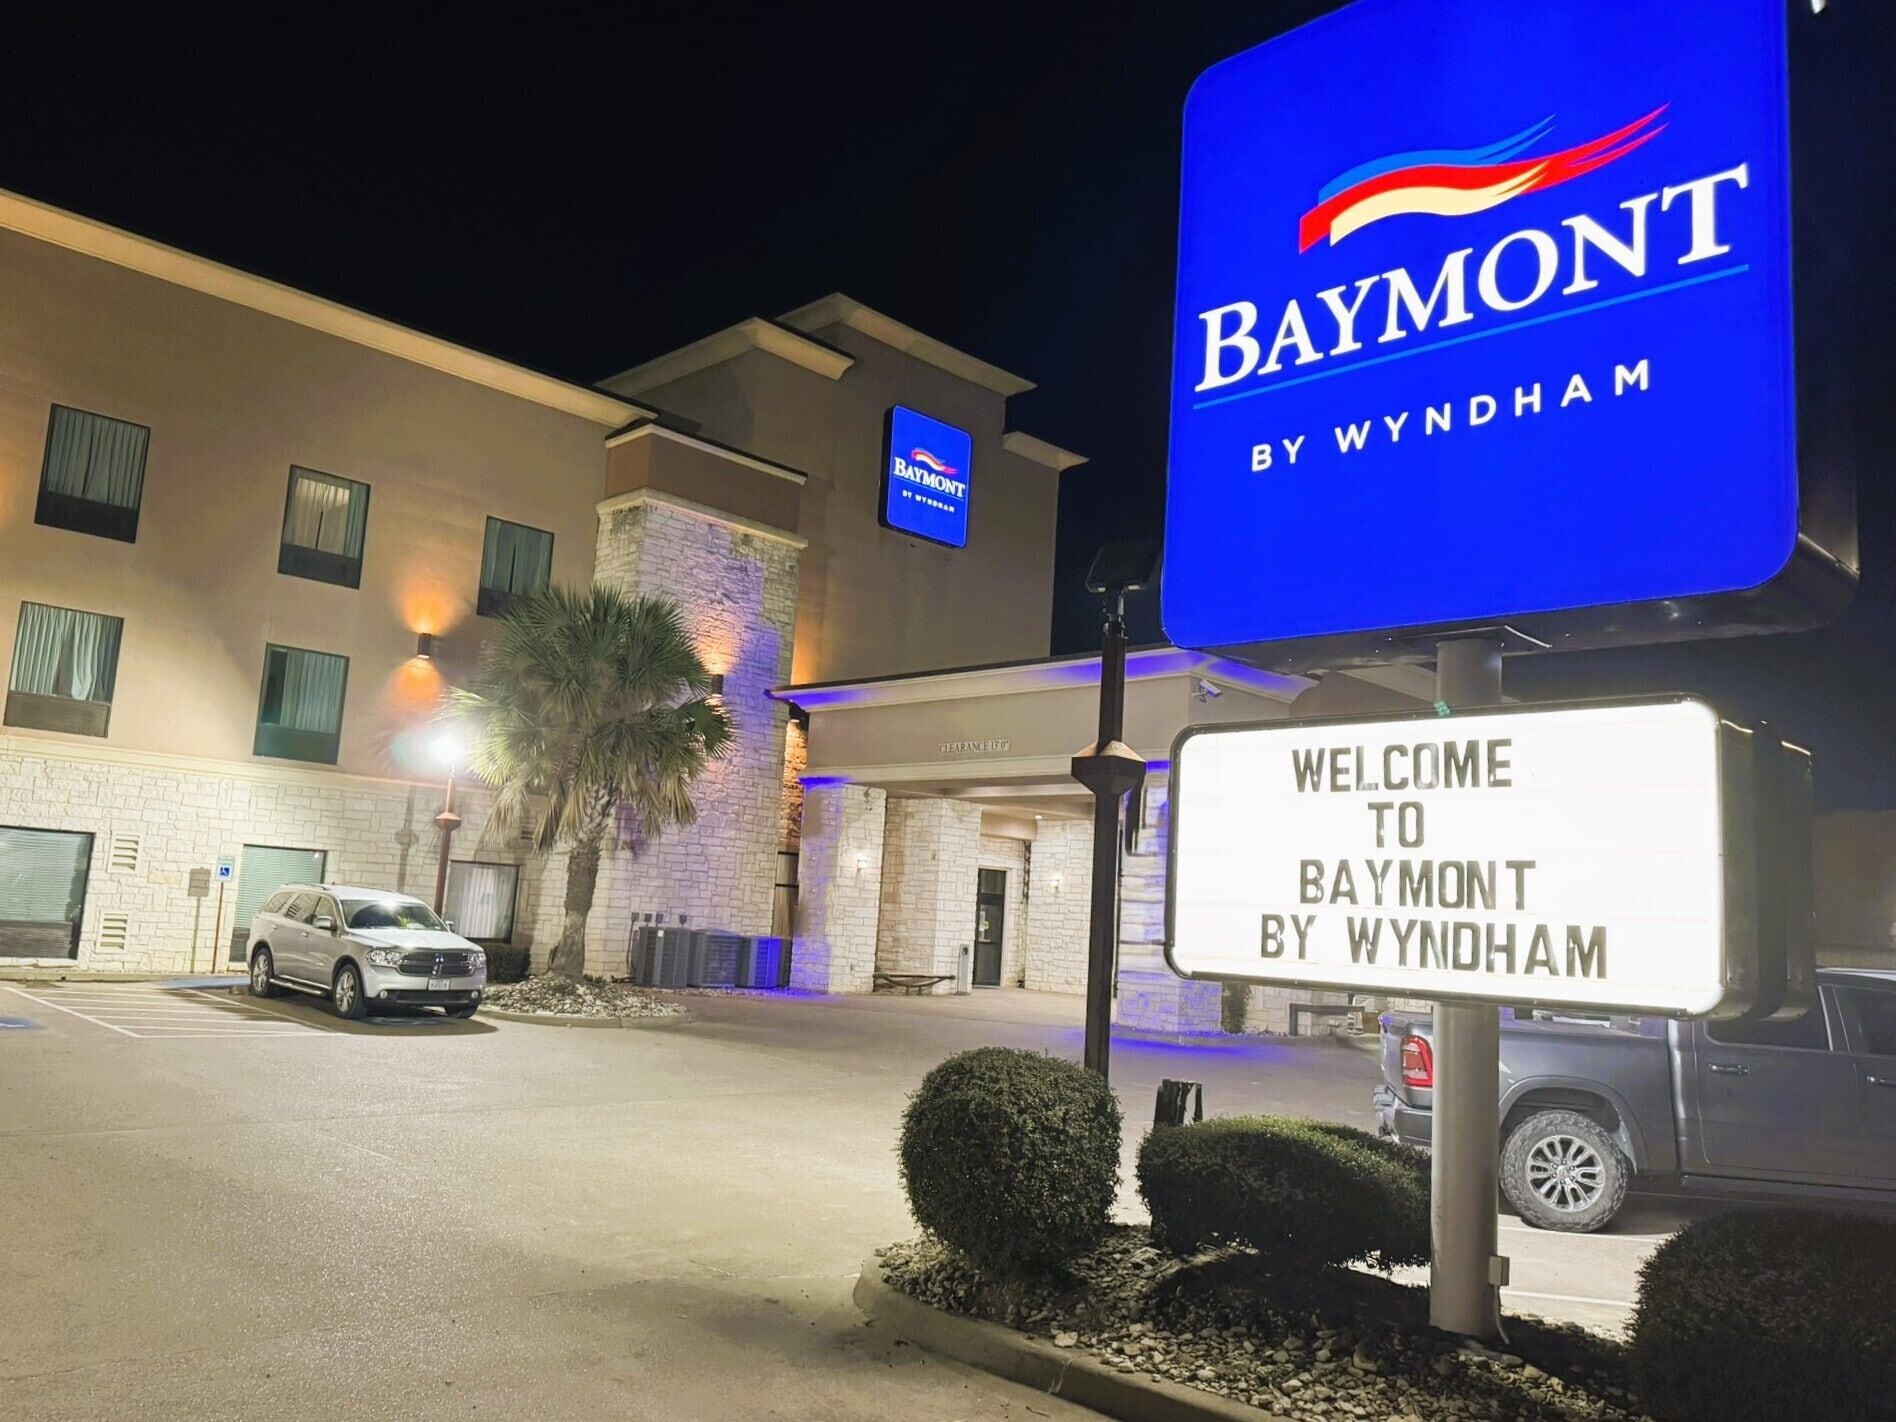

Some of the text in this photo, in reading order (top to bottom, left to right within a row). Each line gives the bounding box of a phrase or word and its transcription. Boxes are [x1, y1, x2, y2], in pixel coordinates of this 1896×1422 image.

[1194, 162, 1749, 393] BAYMONT
[1251, 359, 1650, 473] BY WYNDHAM
[893, 457, 966, 498] BAYMONT
[902, 489, 955, 513] BY WYNDHAM
[939, 741, 988, 754] CLEARANCE
[1292, 738, 1513, 793] WELCOME
[1367, 801, 1425, 848] TO
[1299, 859, 1537, 911] BAYMONT
[1260, 914, 1607, 979] BY WYNDHAM
